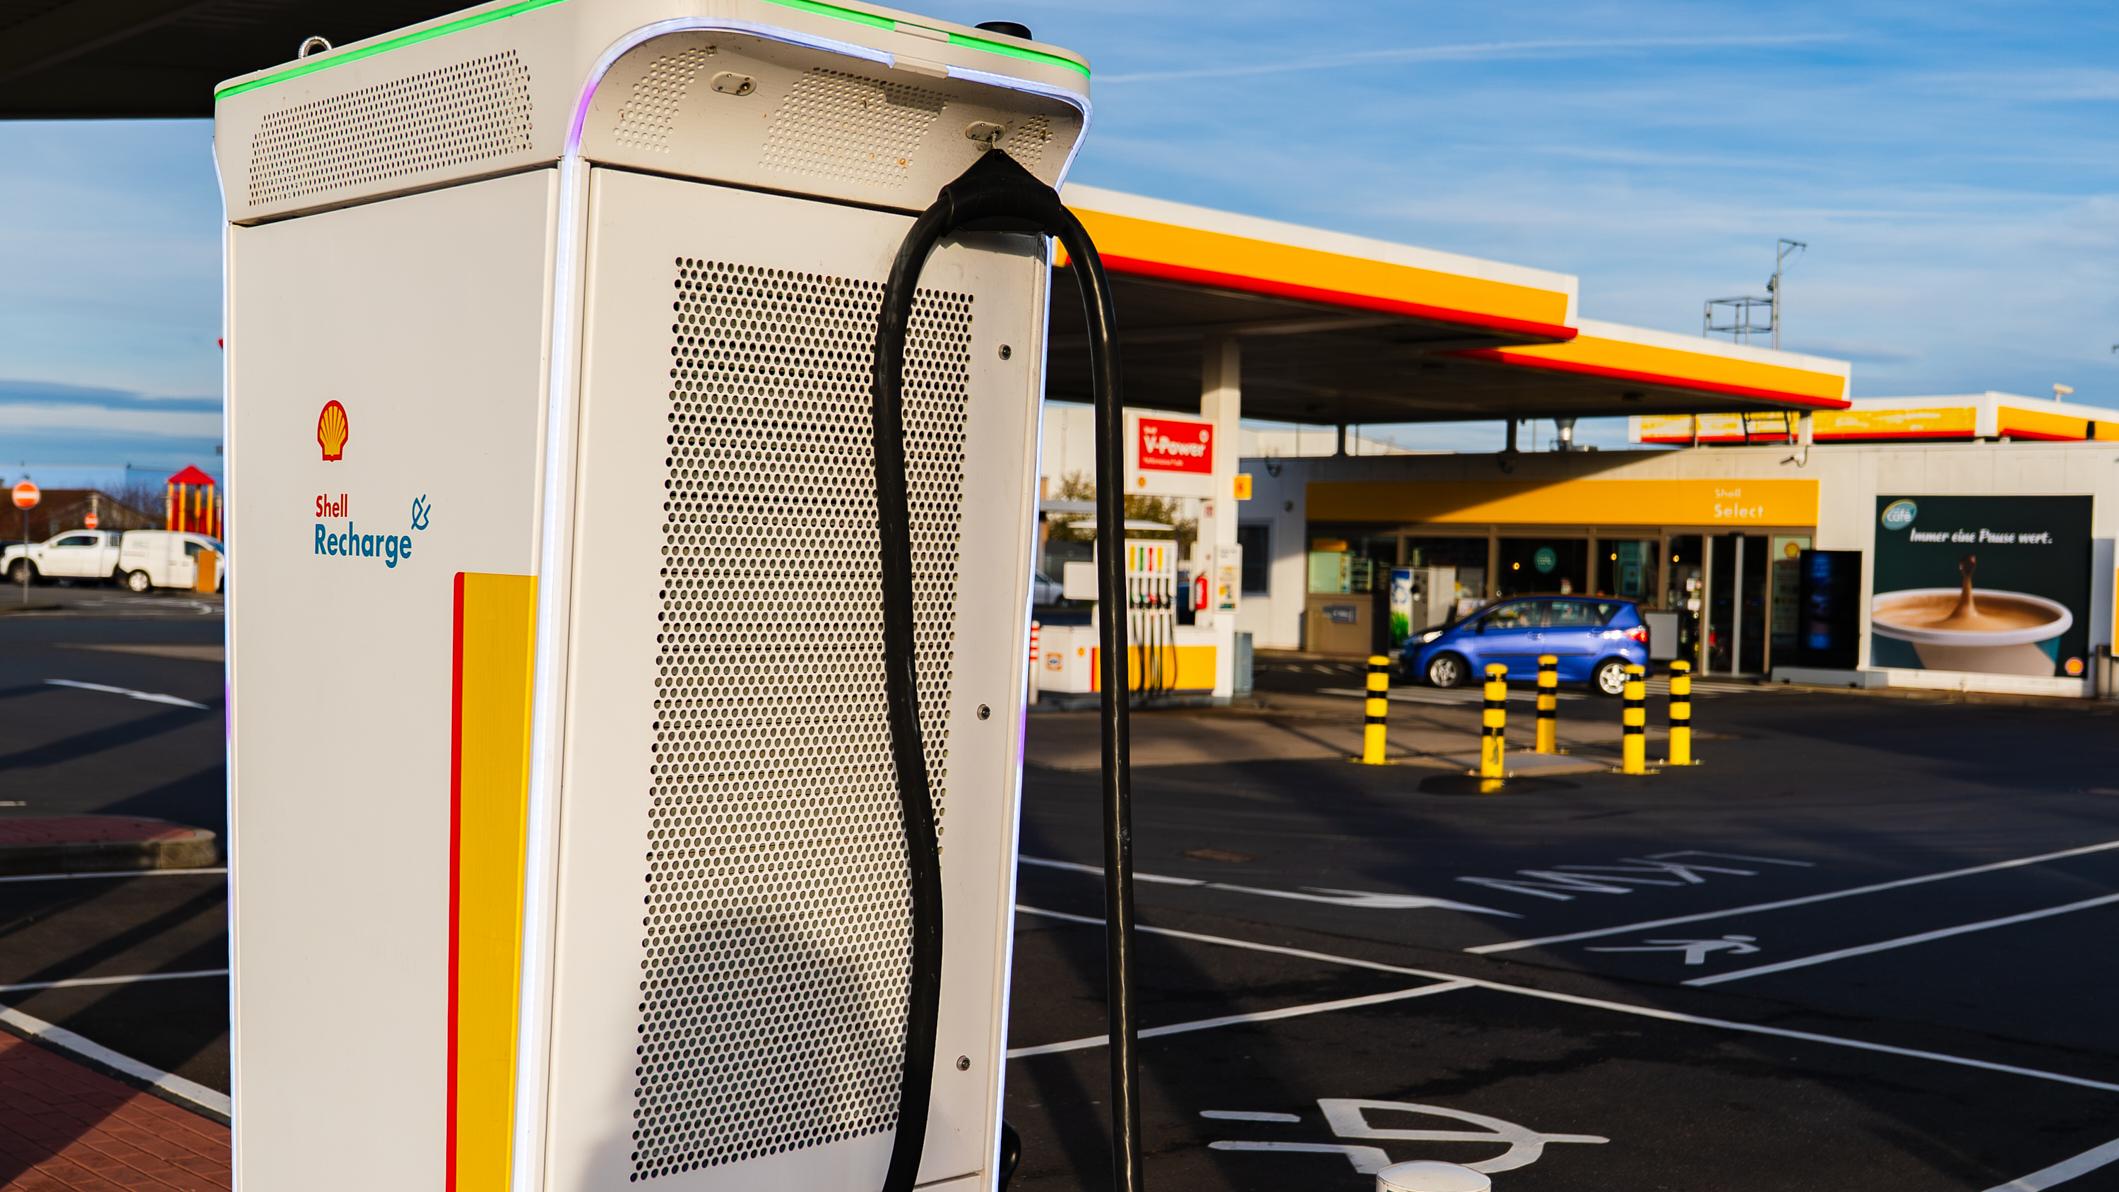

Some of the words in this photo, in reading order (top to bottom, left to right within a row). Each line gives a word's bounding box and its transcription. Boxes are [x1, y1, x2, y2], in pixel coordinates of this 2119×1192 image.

[1143, 435, 1207, 457] V-Power
[315, 493, 349, 518] Shell
[1713, 502, 1764, 518] Select
[314, 521, 413, 569] Recharge
[1909, 527, 1950, 543] Immer
[1951, 528, 1976, 543] eine
[1978, 528, 2016, 544] Pause
[2018, 530, 2053, 545] wert.
